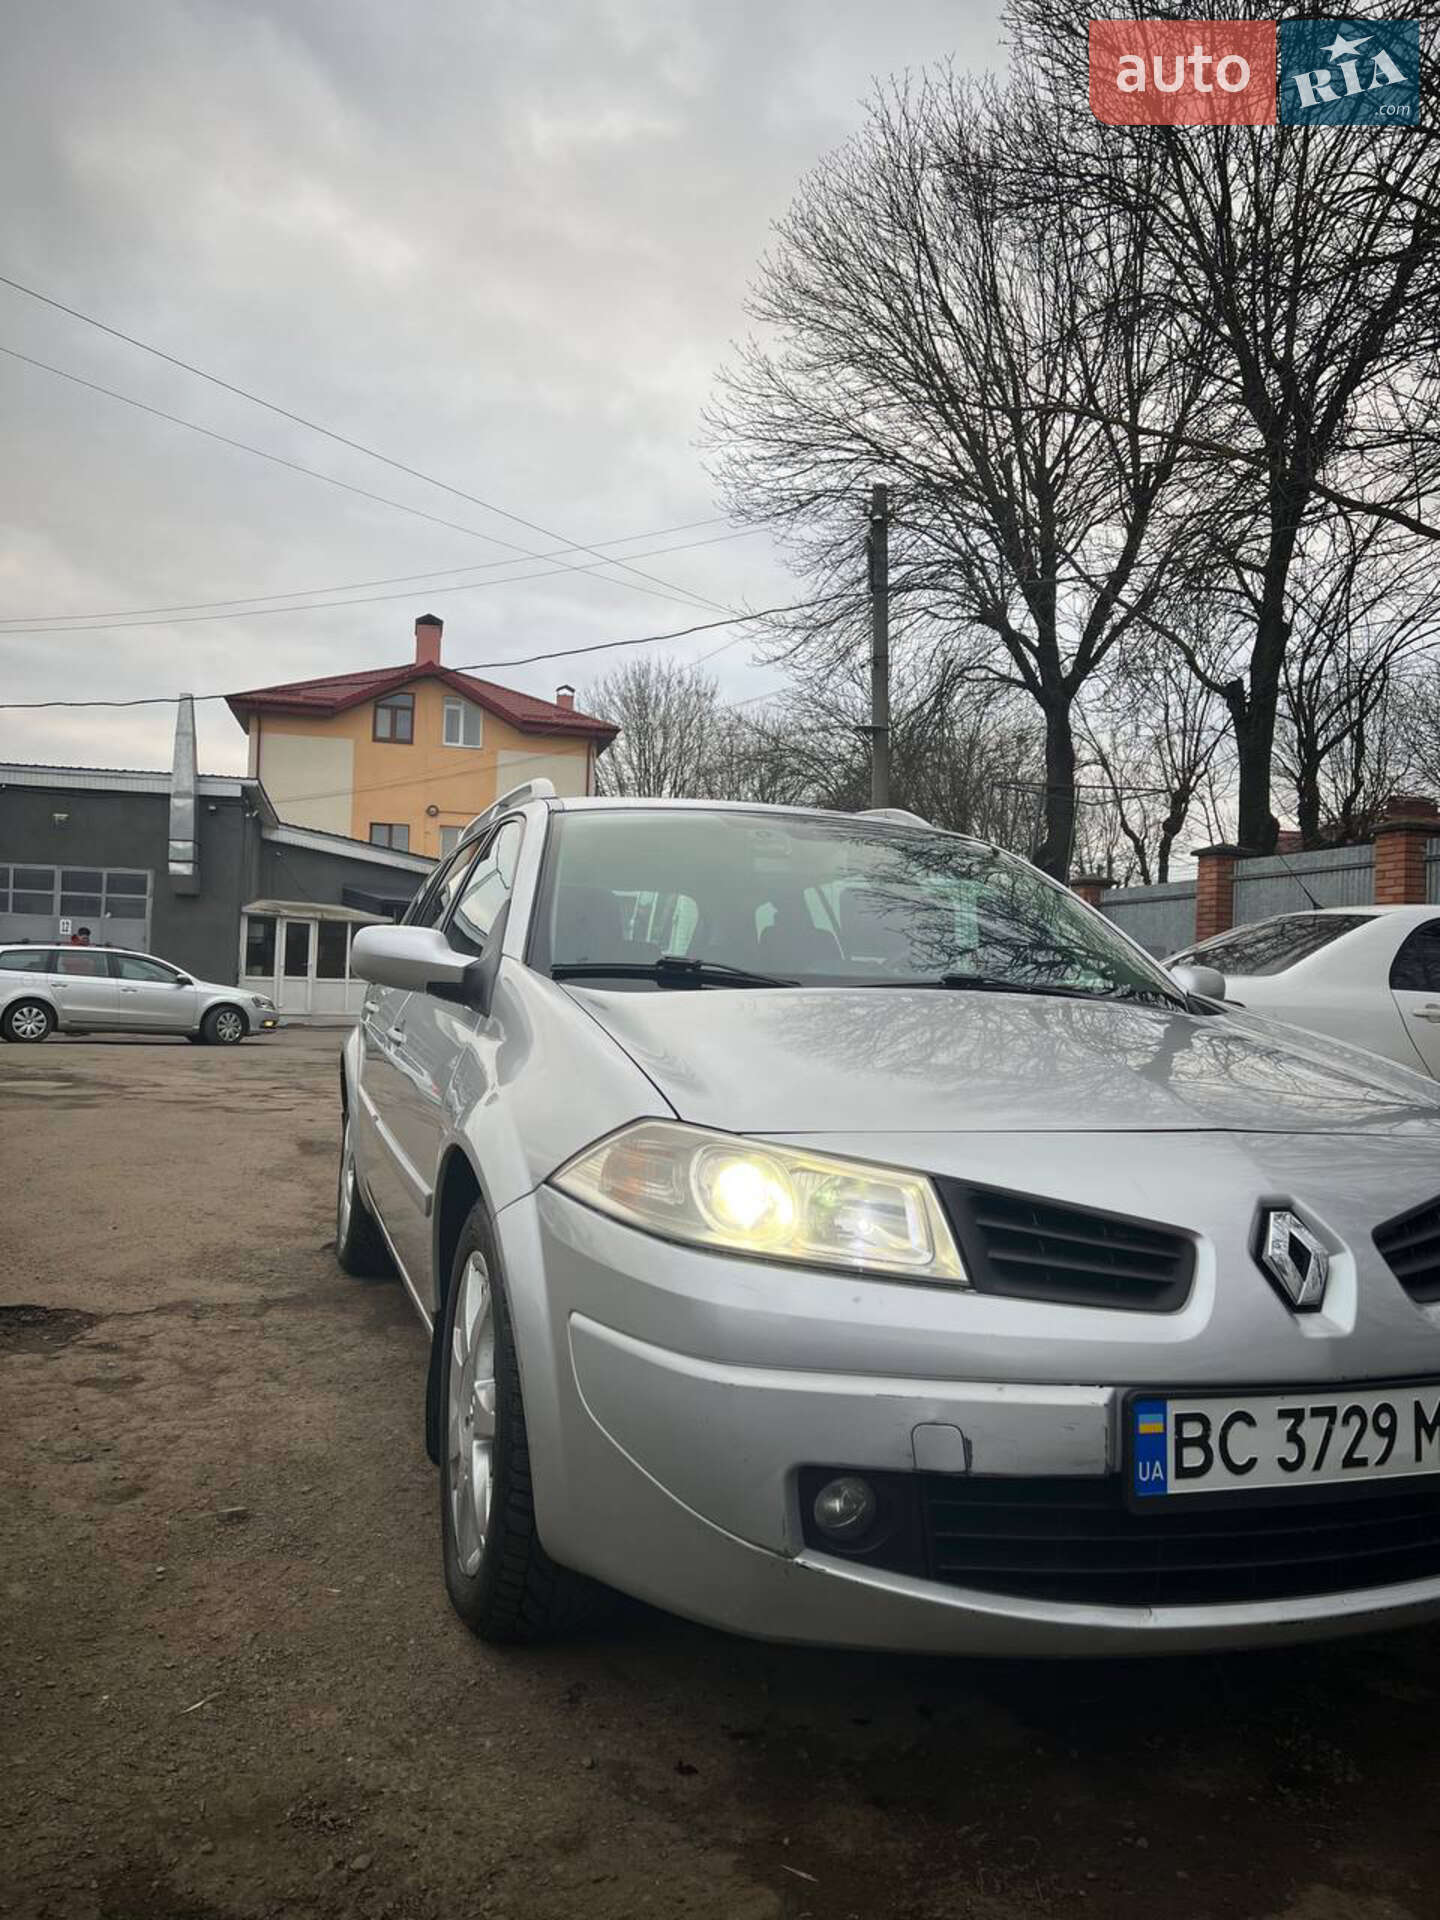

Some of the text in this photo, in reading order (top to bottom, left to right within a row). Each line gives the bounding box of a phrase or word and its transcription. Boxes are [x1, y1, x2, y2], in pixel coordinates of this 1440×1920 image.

[1174, 1410, 1258, 1480] BC
[1277, 1402, 1398, 1473] 3729
[1138, 1460, 1164, 1482] UA
